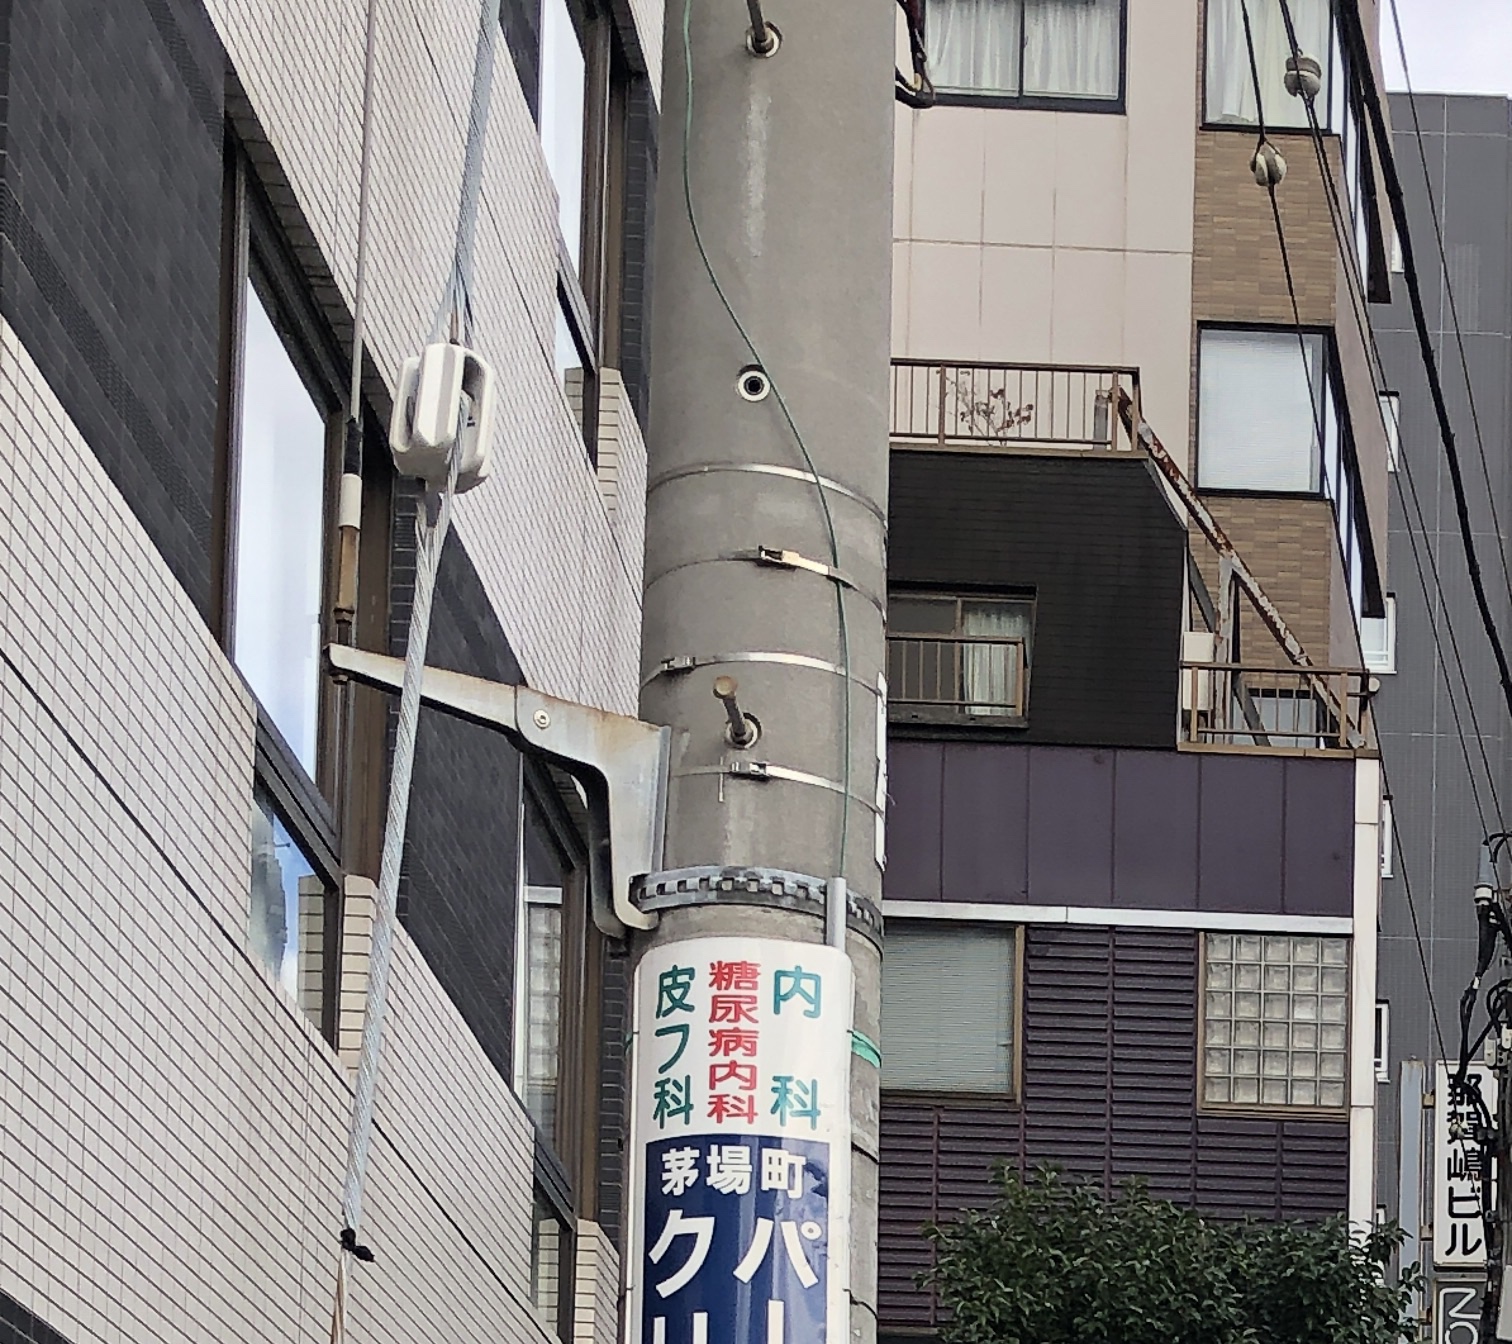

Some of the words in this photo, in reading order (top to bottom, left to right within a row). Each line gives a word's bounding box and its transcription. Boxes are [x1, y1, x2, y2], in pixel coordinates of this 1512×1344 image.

[653, 964, 695, 1130] 皮フ科
[707, 960, 761, 1125] 糖尿病内科
[770, 965, 823, 1130] 内科
[661, 1145, 807, 1199] 茅場町
